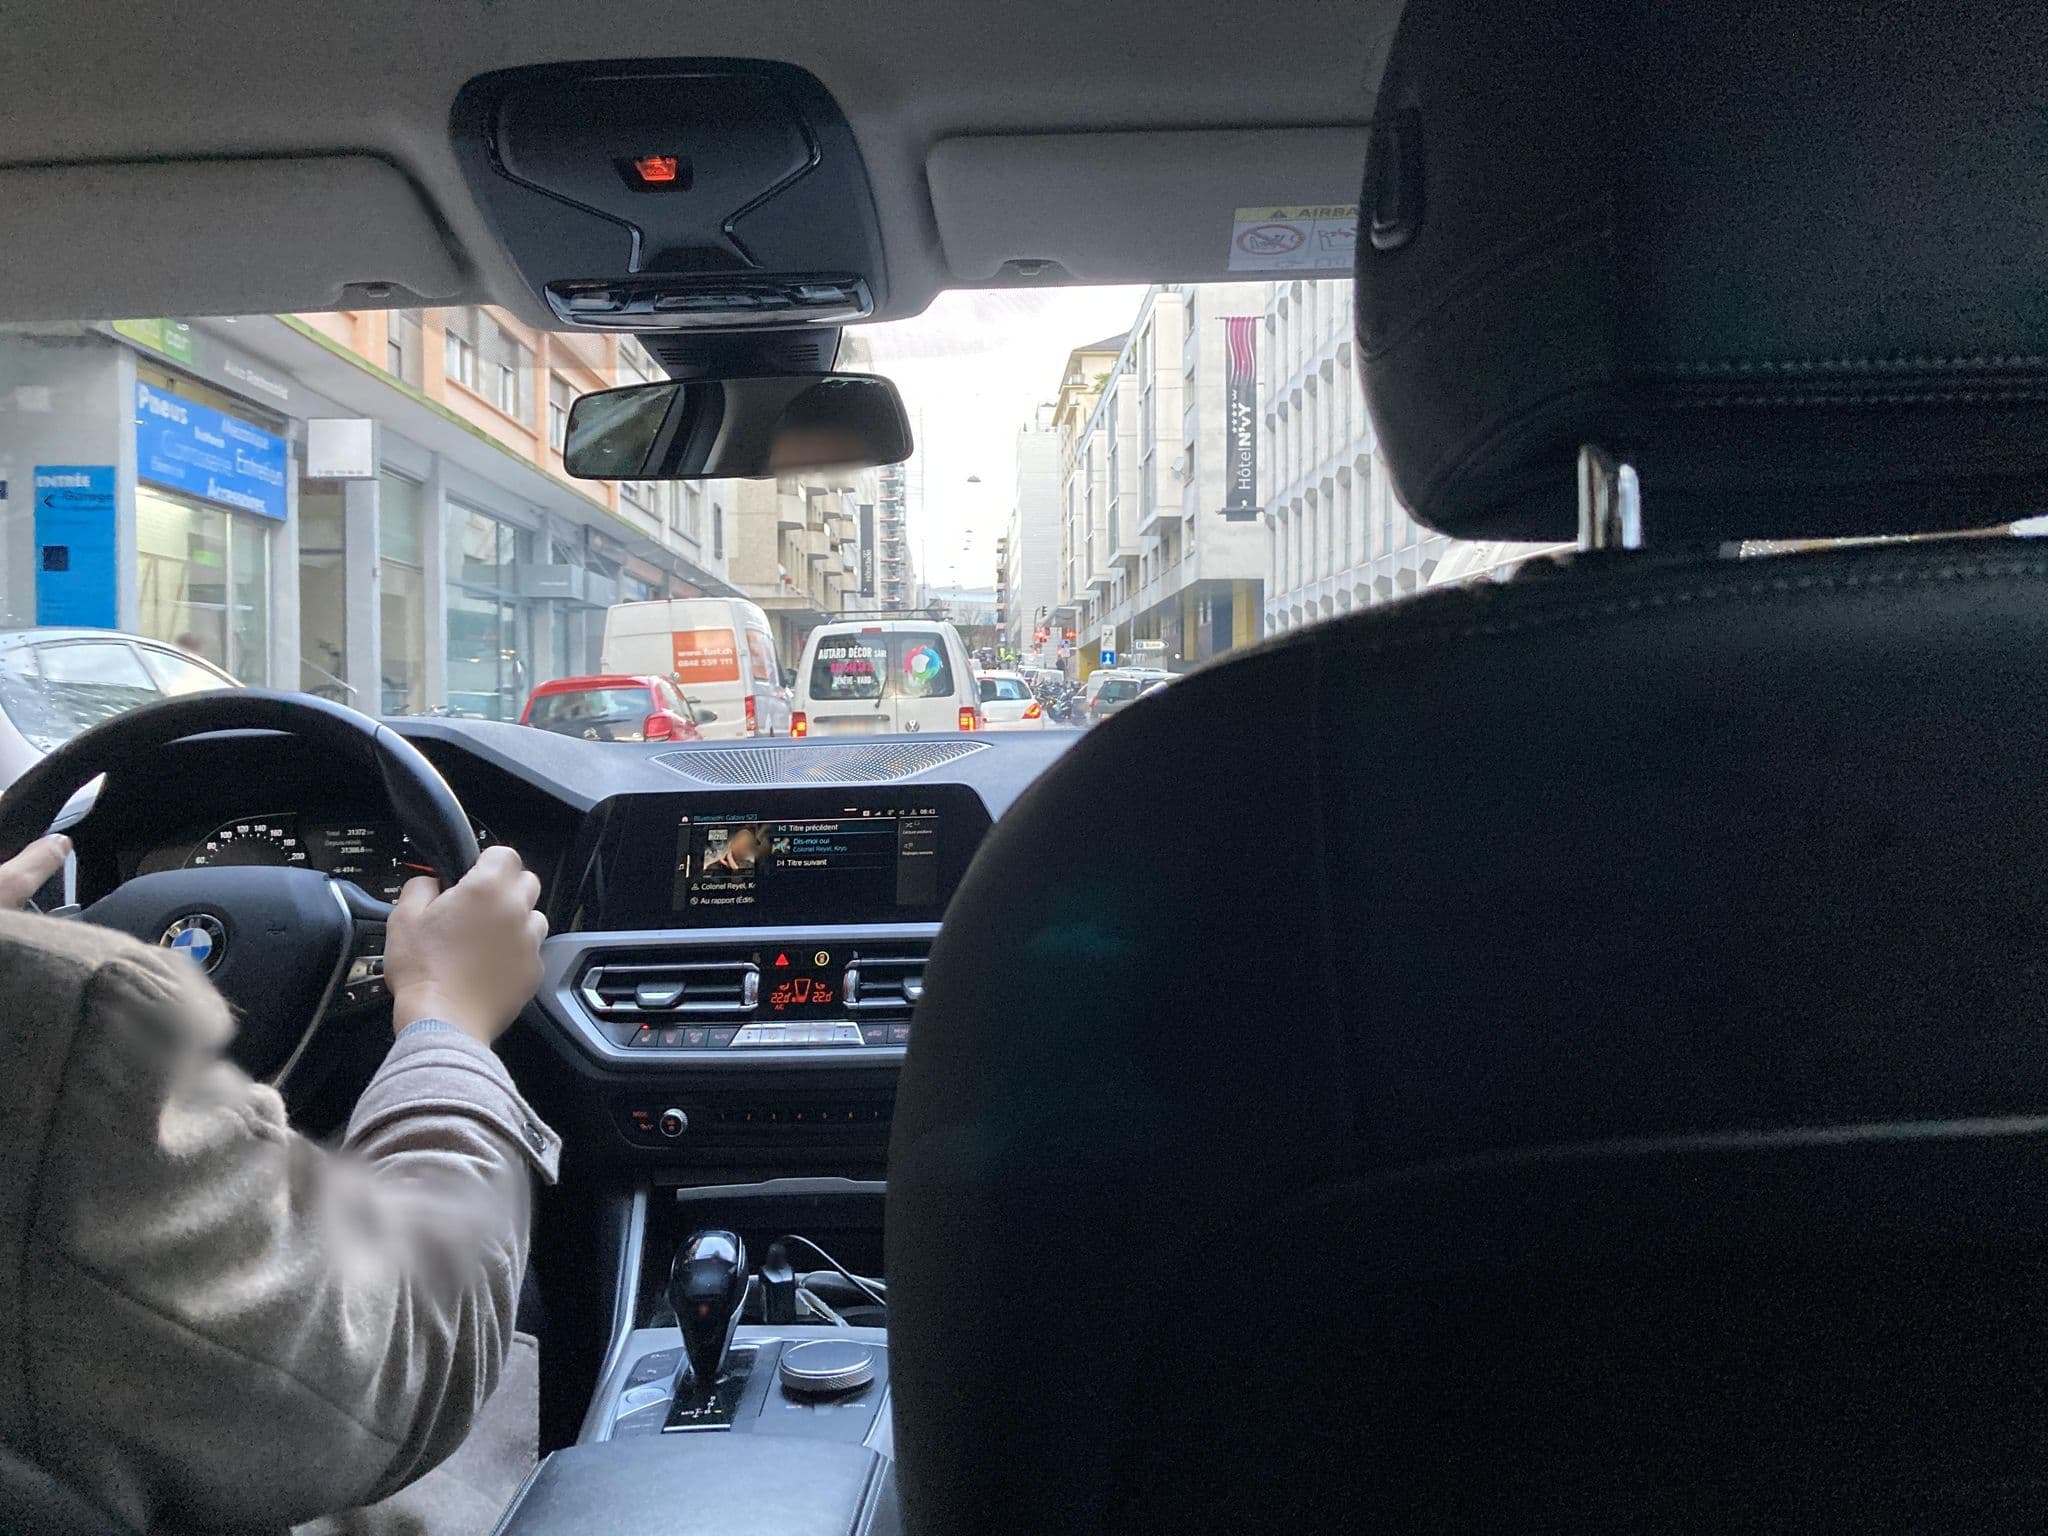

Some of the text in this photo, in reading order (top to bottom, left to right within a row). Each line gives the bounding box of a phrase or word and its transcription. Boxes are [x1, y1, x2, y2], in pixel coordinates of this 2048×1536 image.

[138, 382, 189, 425] Pneus
[818, 648, 846, 660] AUTARD
[848, 645, 872, 658] DÉCOR
[237, 825, 249, 833] 120
[254, 824, 266, 832] 140
[806, 824, 838, 833] précédent
[220, 831, 232, 839] 100
[270, 829, 283, 837] 160
[207, 842, 217, 850] 80
[195, 856, 206, 864] 60
[291, 852, 305, 860] 200
[391, 857, 397, 867] 1
[804, 859, 828, 867] suivant
[701, 883, 727, 891] Colonel
[711, 896, 735, 906] rapport
